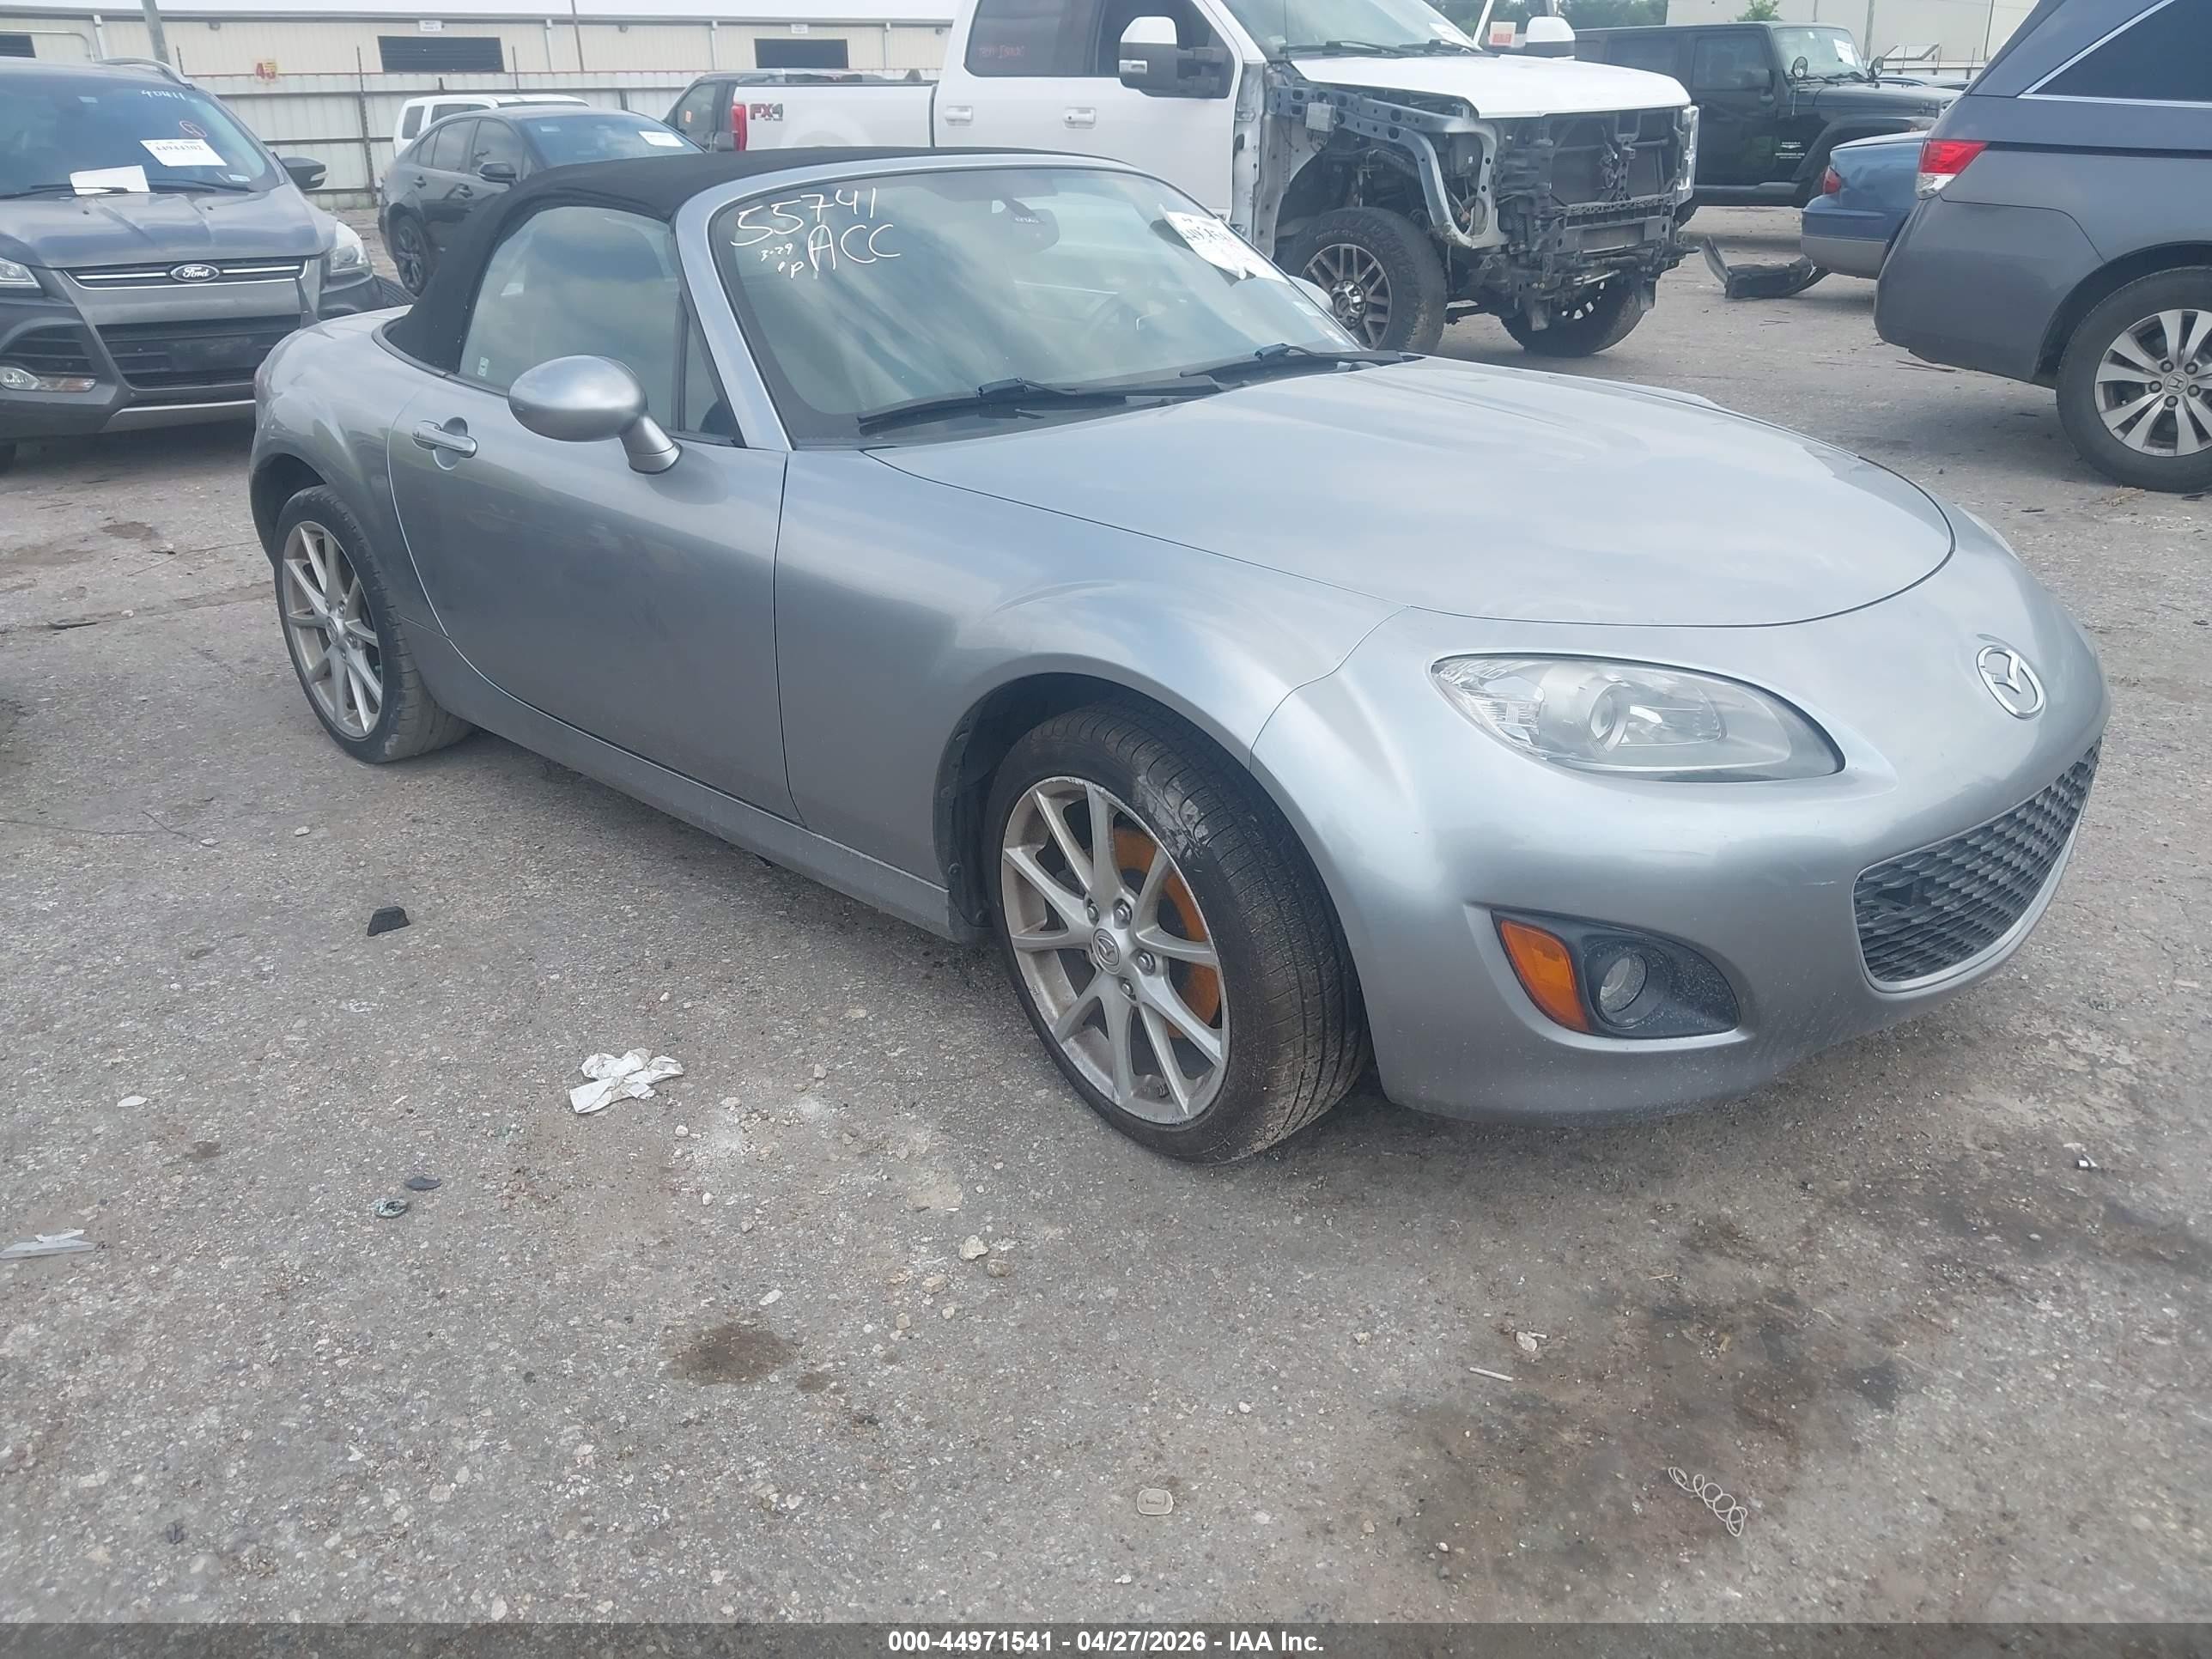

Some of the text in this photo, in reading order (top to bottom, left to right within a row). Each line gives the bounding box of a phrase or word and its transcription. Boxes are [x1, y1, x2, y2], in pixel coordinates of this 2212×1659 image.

[750, 103, 783, 119] FX4
[730, 188, 877, 246] 55741
[808, 224, 901, 271] ACC
[183, 266, 210, 278] Ford
